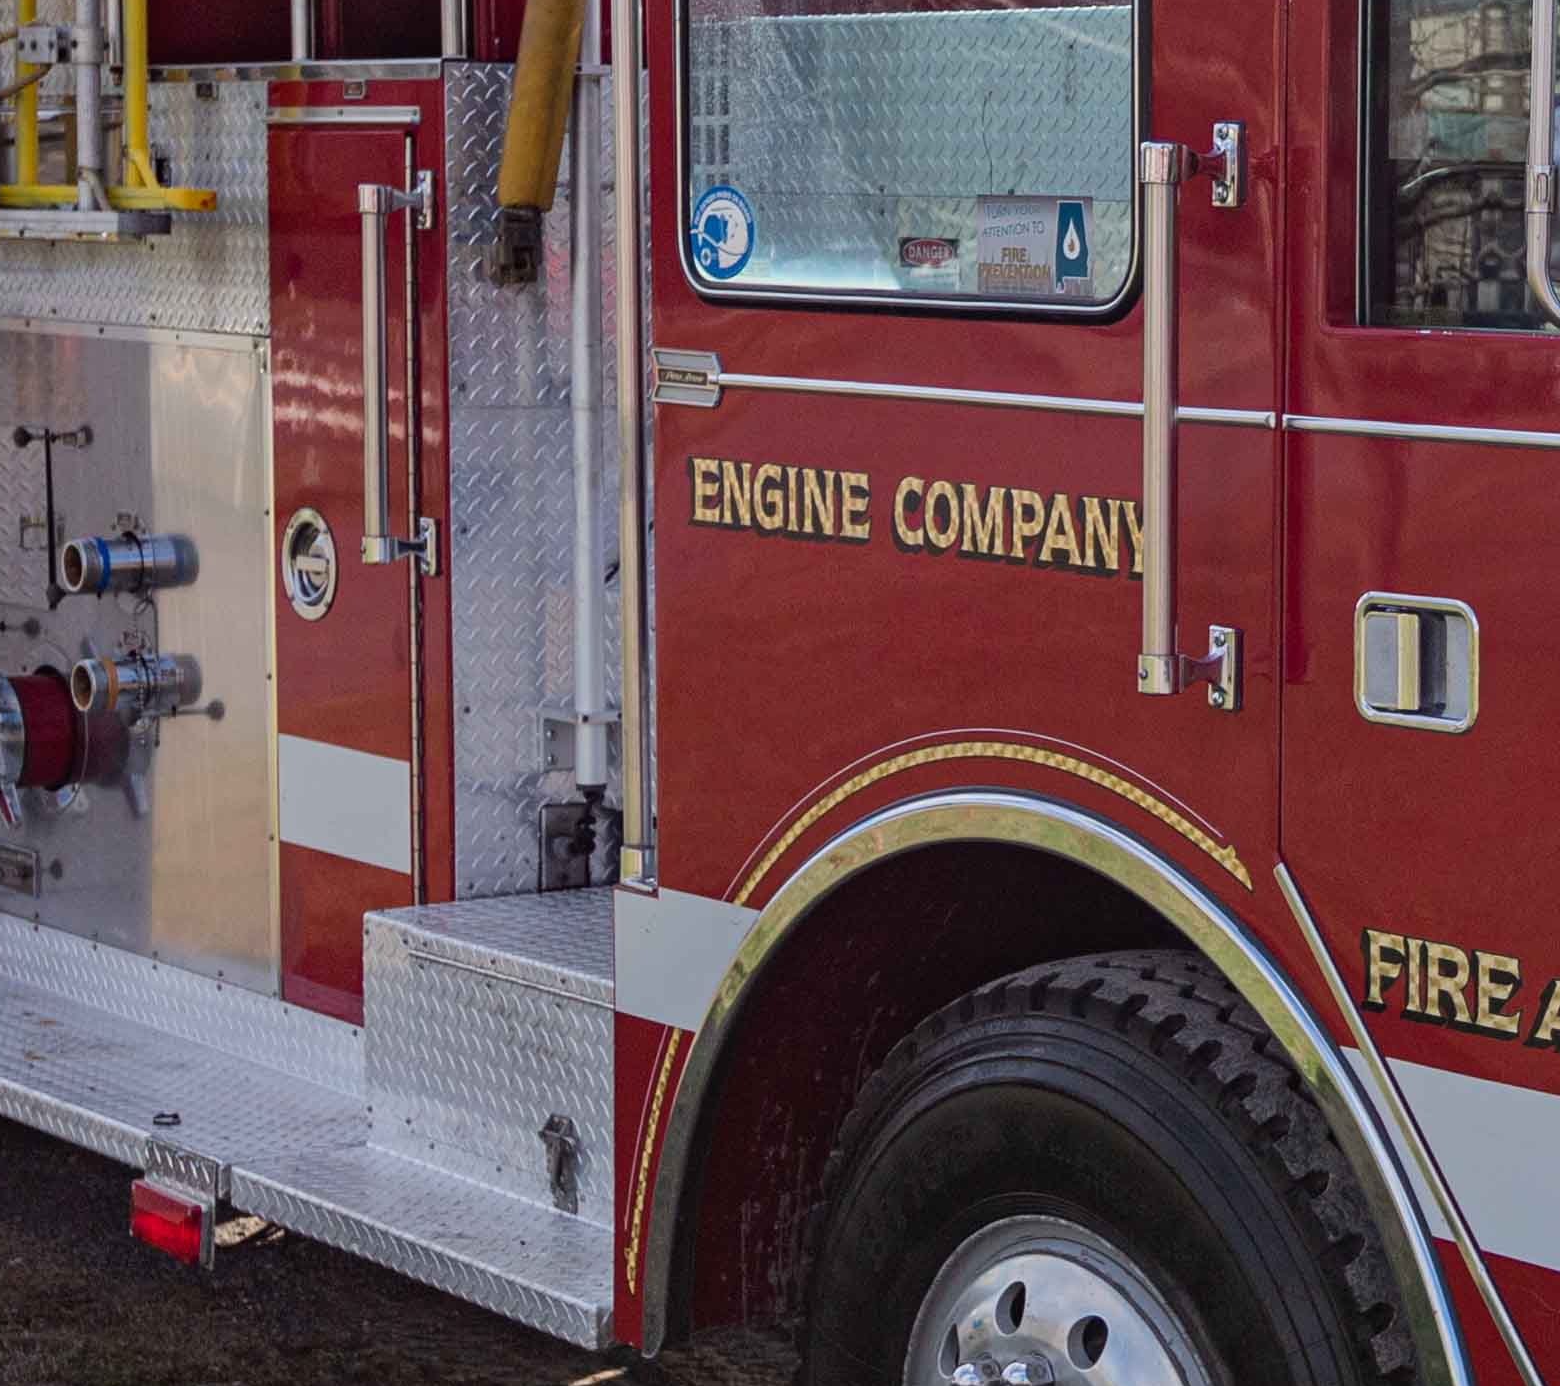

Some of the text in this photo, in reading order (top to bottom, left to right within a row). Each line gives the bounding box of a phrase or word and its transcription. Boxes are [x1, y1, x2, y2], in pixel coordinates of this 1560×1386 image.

[983, 221, 1046, 237] ATTENTION TO
[907, 244, 953, 260] DANGER
[1001, 247, 1027, 263] FIRE
[978, 263, 1050, 279] PREVENTION
[690, 456, 872, 543] ENGINE
[1362, 927, 1522, 1037] FIRE
